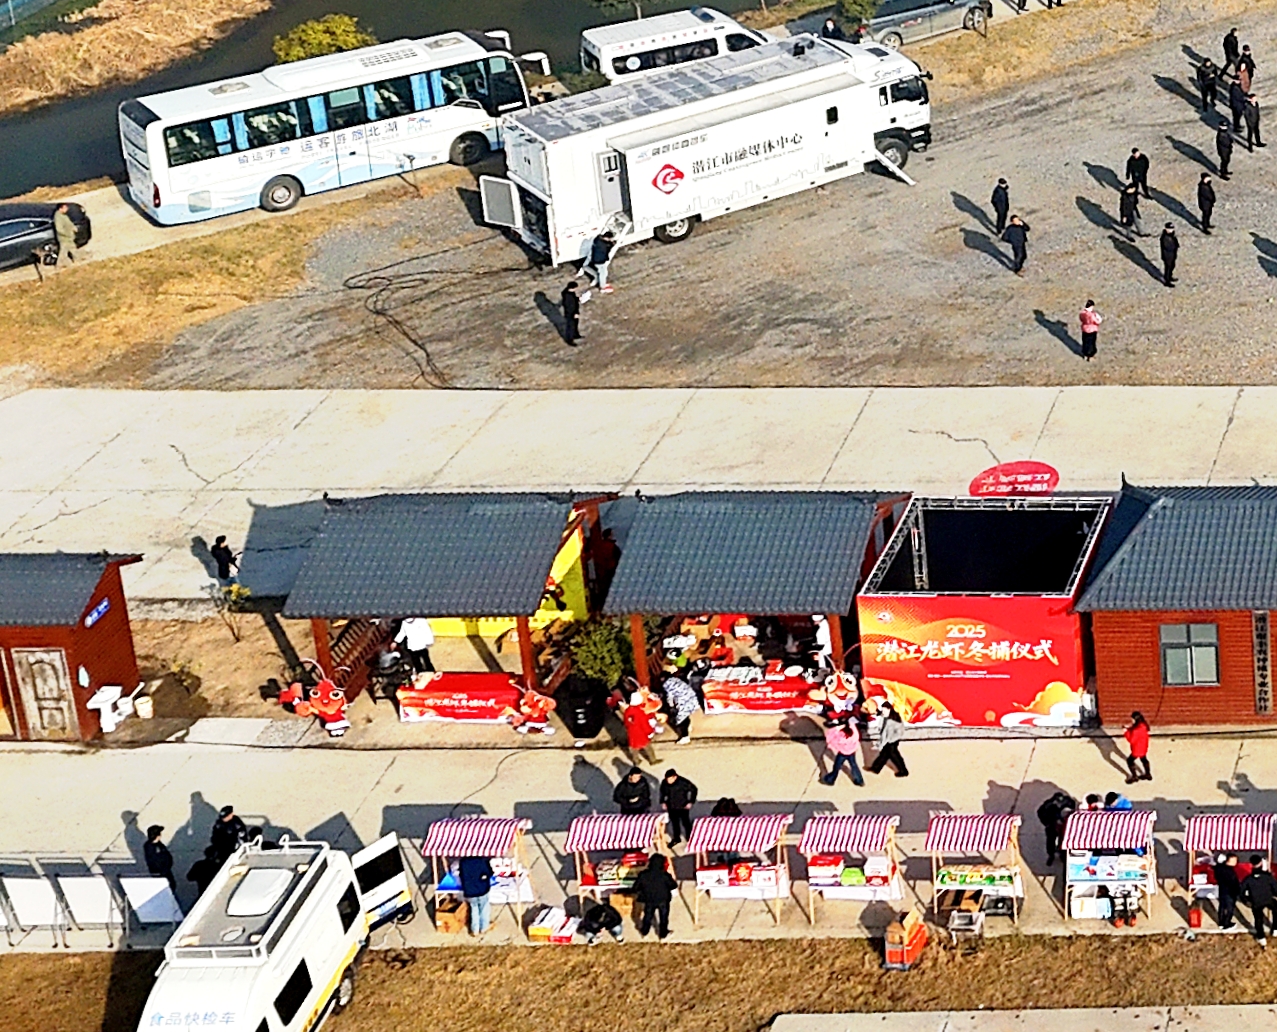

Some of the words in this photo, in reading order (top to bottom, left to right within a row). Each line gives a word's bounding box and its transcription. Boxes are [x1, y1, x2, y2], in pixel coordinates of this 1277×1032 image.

[692, 132, 803, 174] 潜江市融媒体中心
[946, 624, 986, 638] 2025
[874, 639, 1059, 665] 潜江龙虾冬捕仪式
[149, 1012, 236, 1027] 食品快检车
